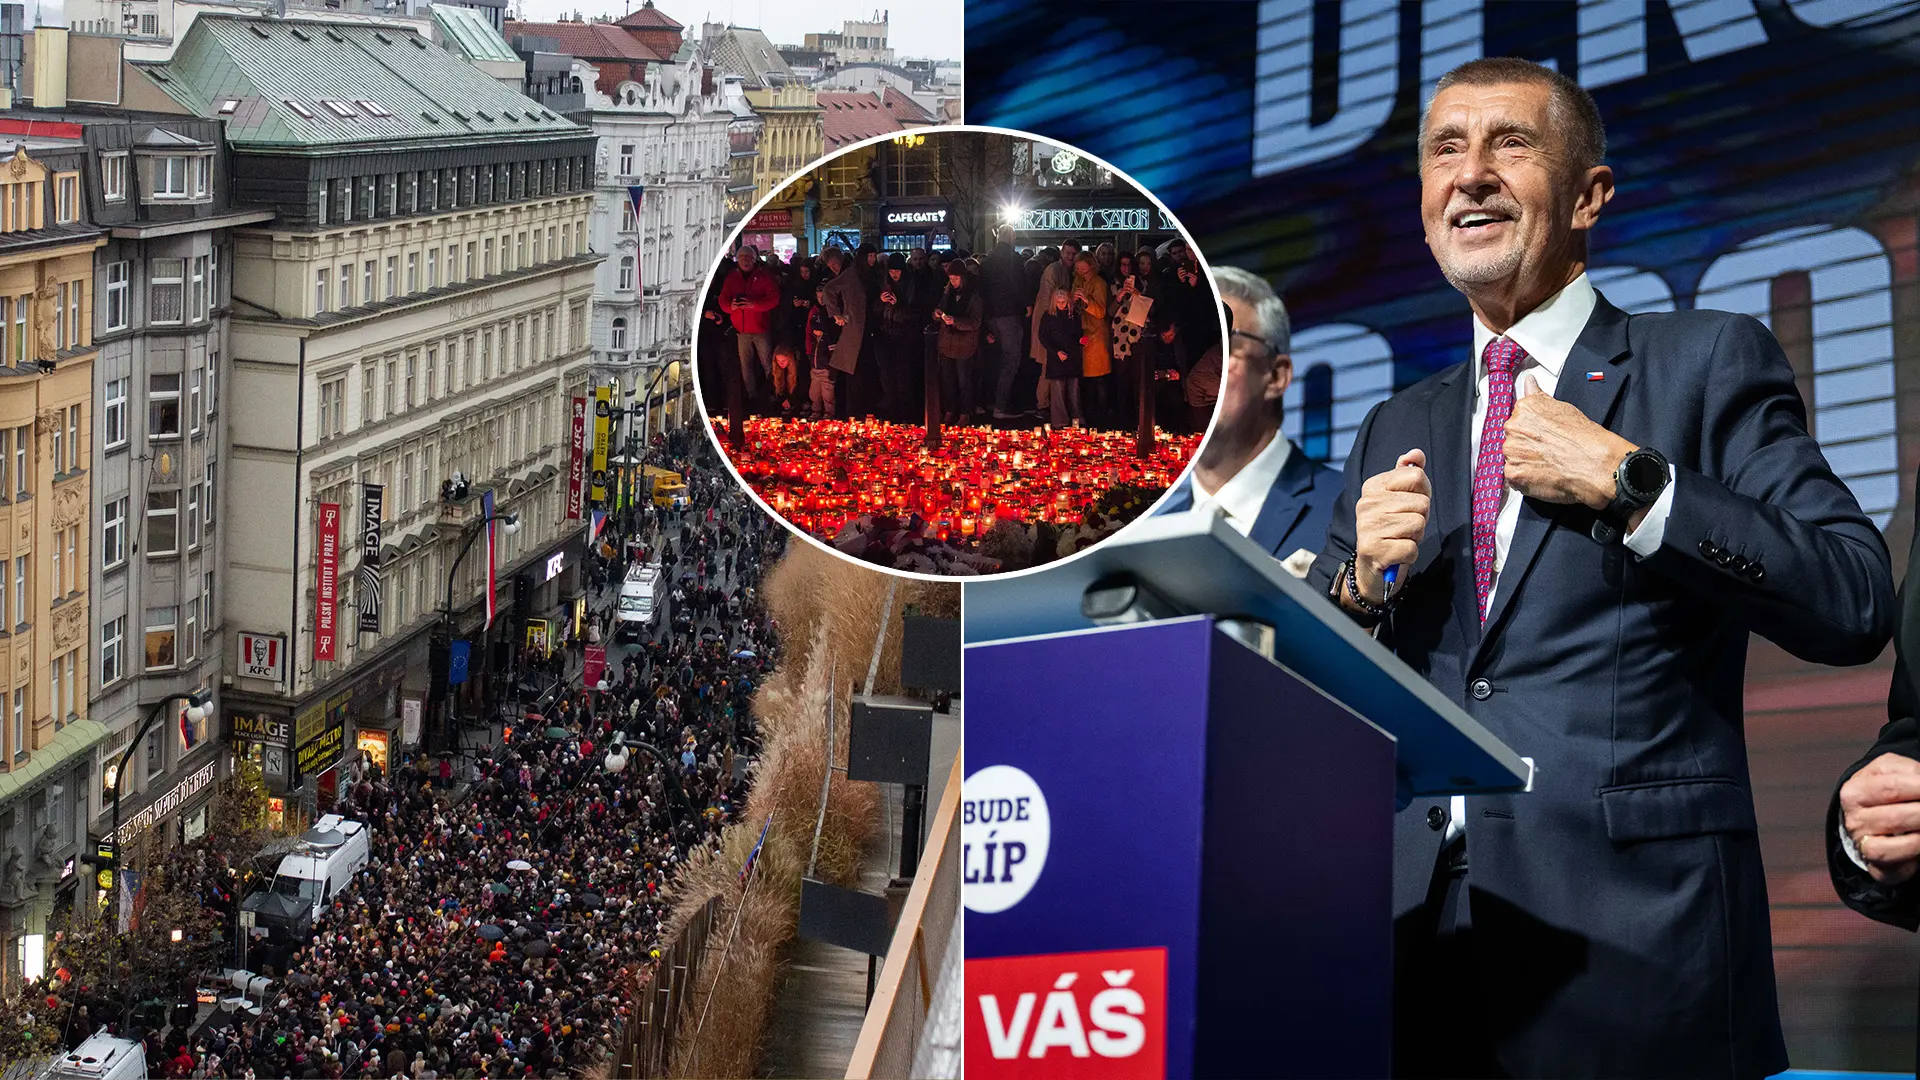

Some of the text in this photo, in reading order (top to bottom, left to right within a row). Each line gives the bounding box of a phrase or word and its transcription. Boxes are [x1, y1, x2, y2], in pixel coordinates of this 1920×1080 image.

[888, 212, 938, 223] CAFE GATE
[1015, 206, 1095, 230] RZLINOVÝ
[1101, 208, 1150, 230] SALON
[575, 424, 583, 449] KFC
[572, 457, 581, 481] KFC
[570, 489, 579, 514] KFC
[365, 498, 380, 557] IMAGE
[323, 533, 335, 557] PRAZE
[546, 552, 564, 581] KFC
[322, 566, 333, 599] INSTITUT
[320, 601, 333, 629] POLSKÝ
[249, 665, 271, 676] KFC
[234, 716, 288, 738] IMAGE
[319, 726, 343, 750] METRO
[964, 796, 1031, 825] BUDE
[964, 829, 1027, 884] LÍP
[978, 969, 1147, 1060] VÁŠ
